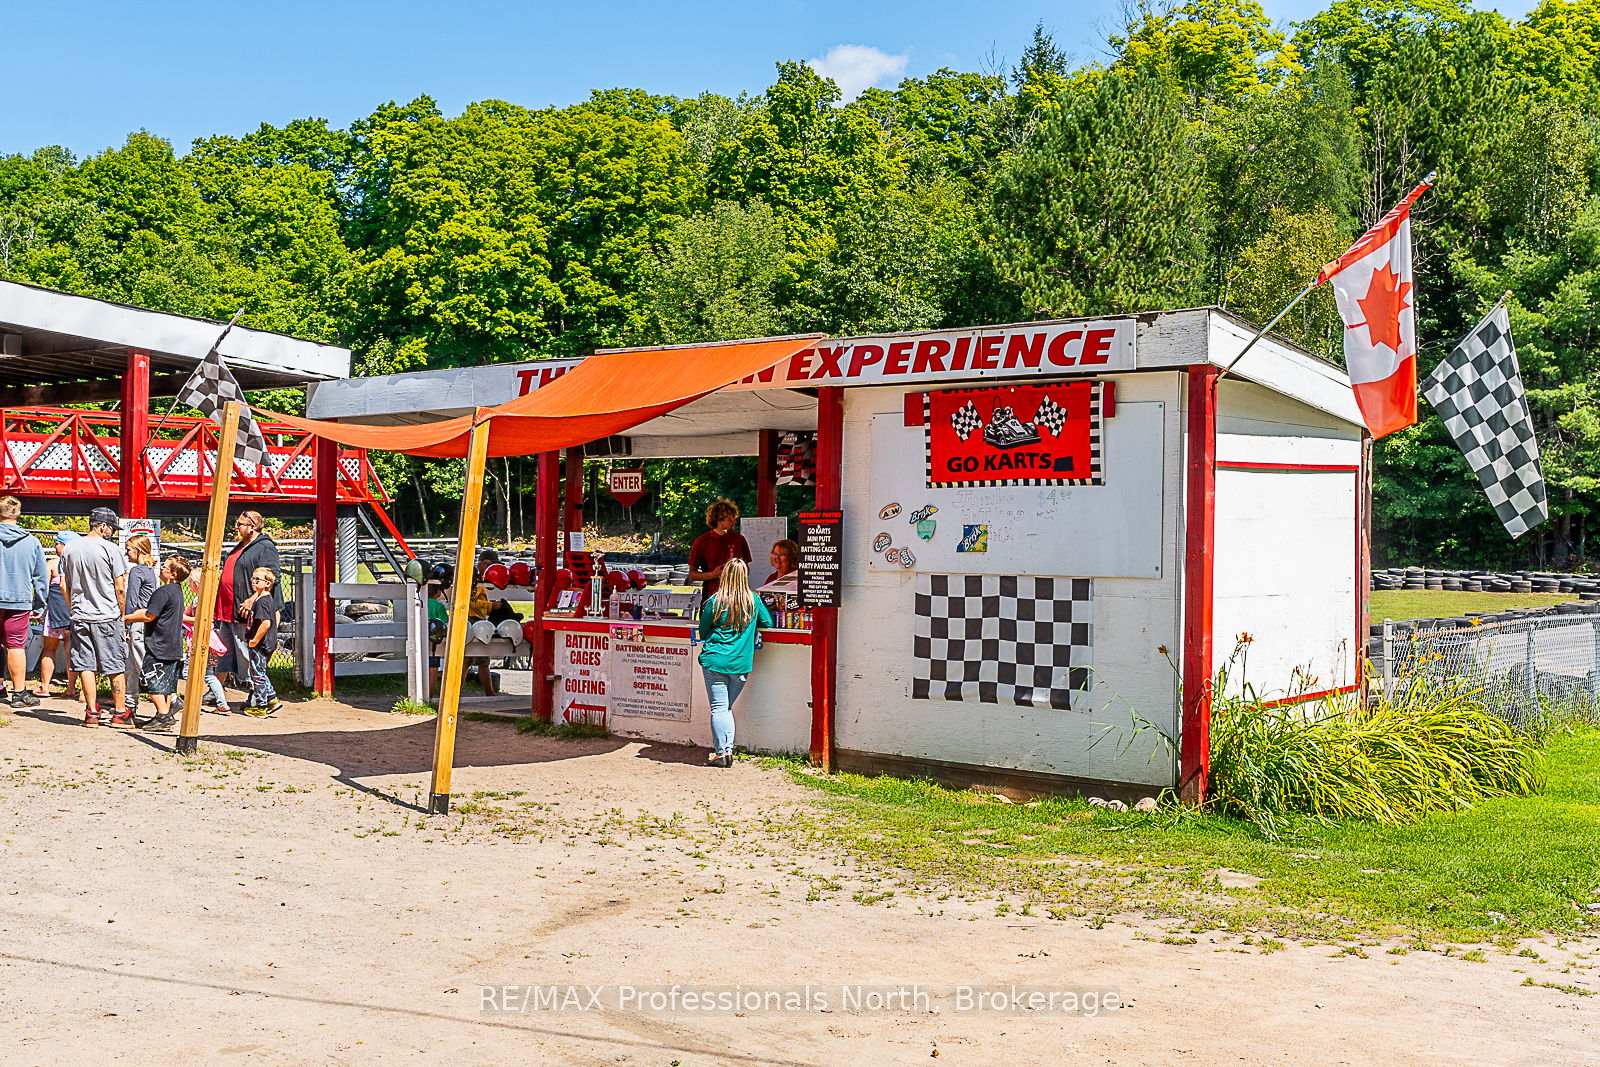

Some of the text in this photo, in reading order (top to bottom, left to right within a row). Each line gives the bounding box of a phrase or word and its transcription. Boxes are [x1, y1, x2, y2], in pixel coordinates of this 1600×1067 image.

[517, 365, 577, 397] TH
[786, 329, 1116, 381] EXPERIENCE
[947, 453, 1053, 472] GO KARTS
[613, 476, 640, 490] ENTER
[816, 527, 831, 535] KARTS
[648, 592, 672, 608] ONLY
[565, 634, 609, 650] BATTING
[615, 644, 689, 656] BATTING CAGE RULES
[570, 650, 601, 666] CAGES
[633, 666, 668, 675] FASTBALL
[565, 678, 606, 695] GOLFING
[633, 681, 668, 691] SOFTBALL
[569, 708, 587, 724] THIS
